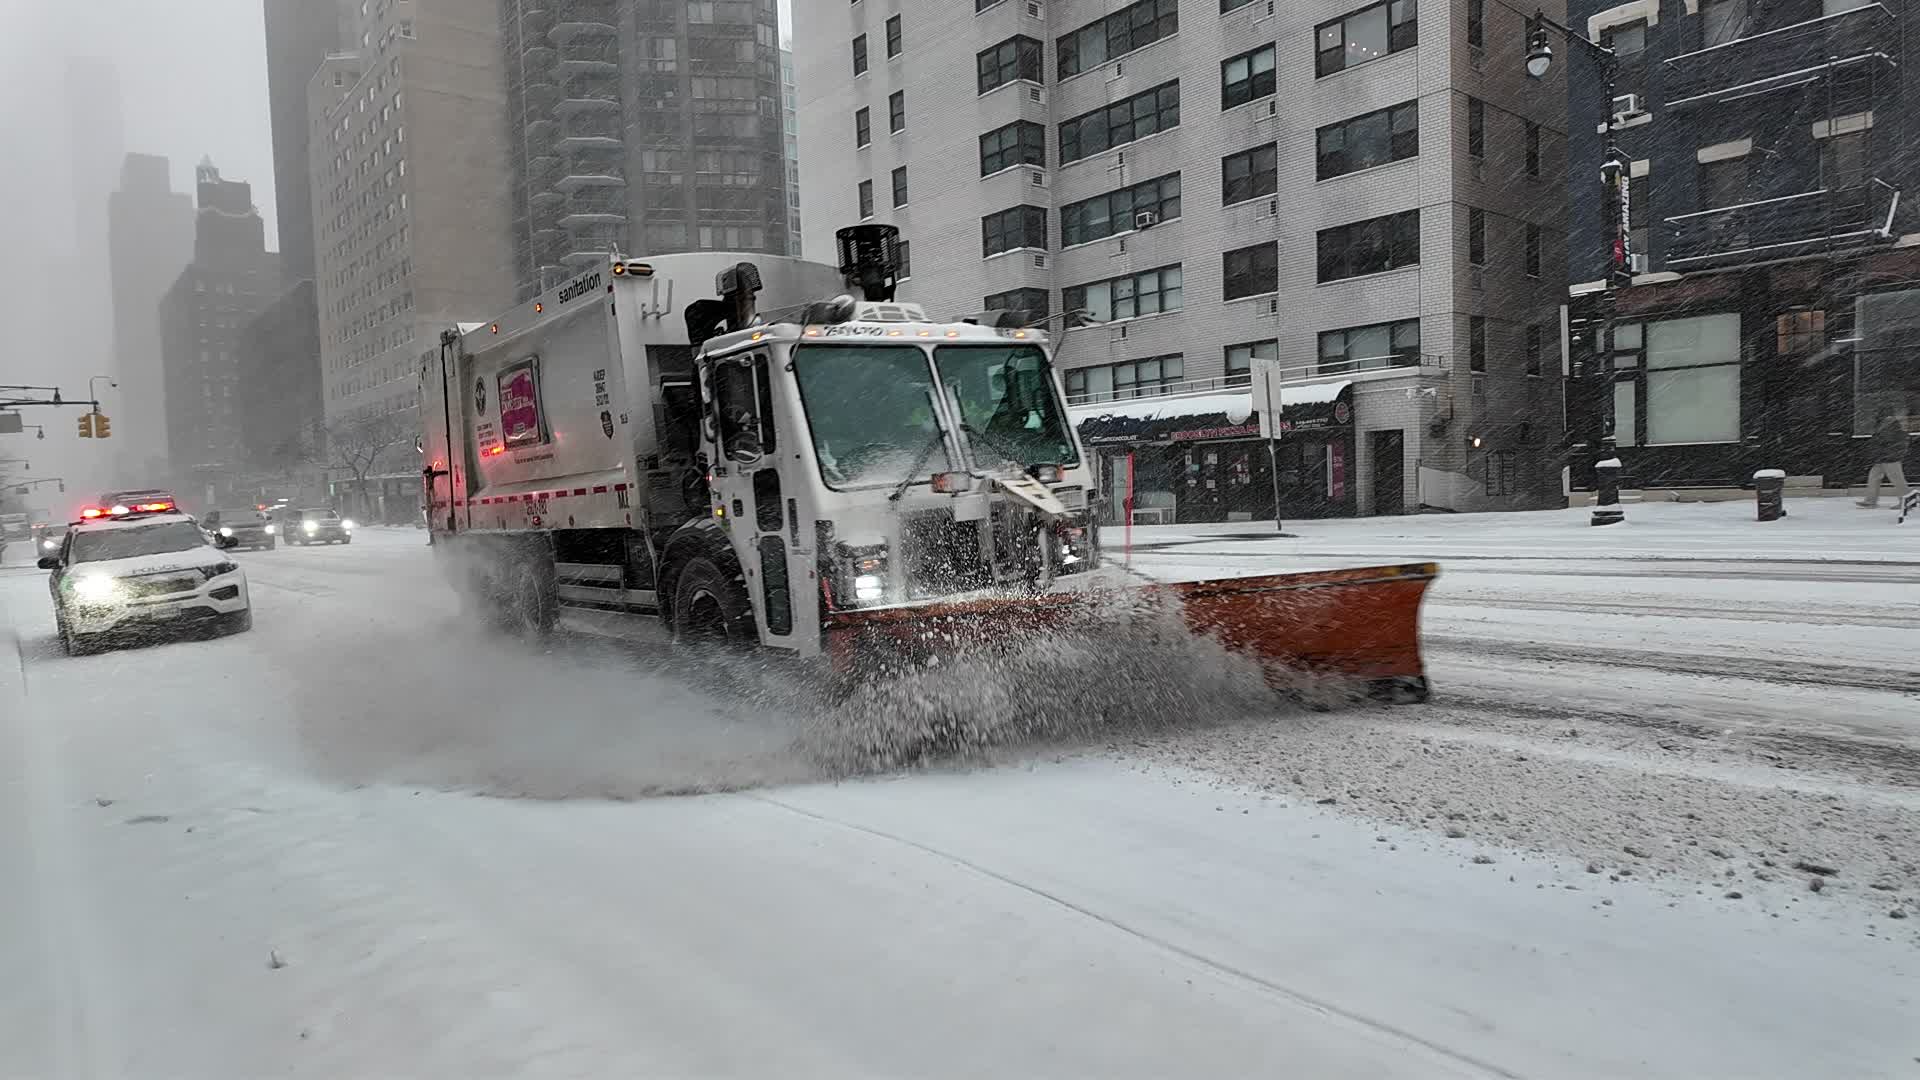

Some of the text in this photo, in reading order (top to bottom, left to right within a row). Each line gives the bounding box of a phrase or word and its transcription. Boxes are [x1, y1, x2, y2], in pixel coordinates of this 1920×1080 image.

[1621, 175, 1630, 232] AMAZING
[558, 272, 601, 304] sanitation
[132, 563, 180, 574] POLICE
